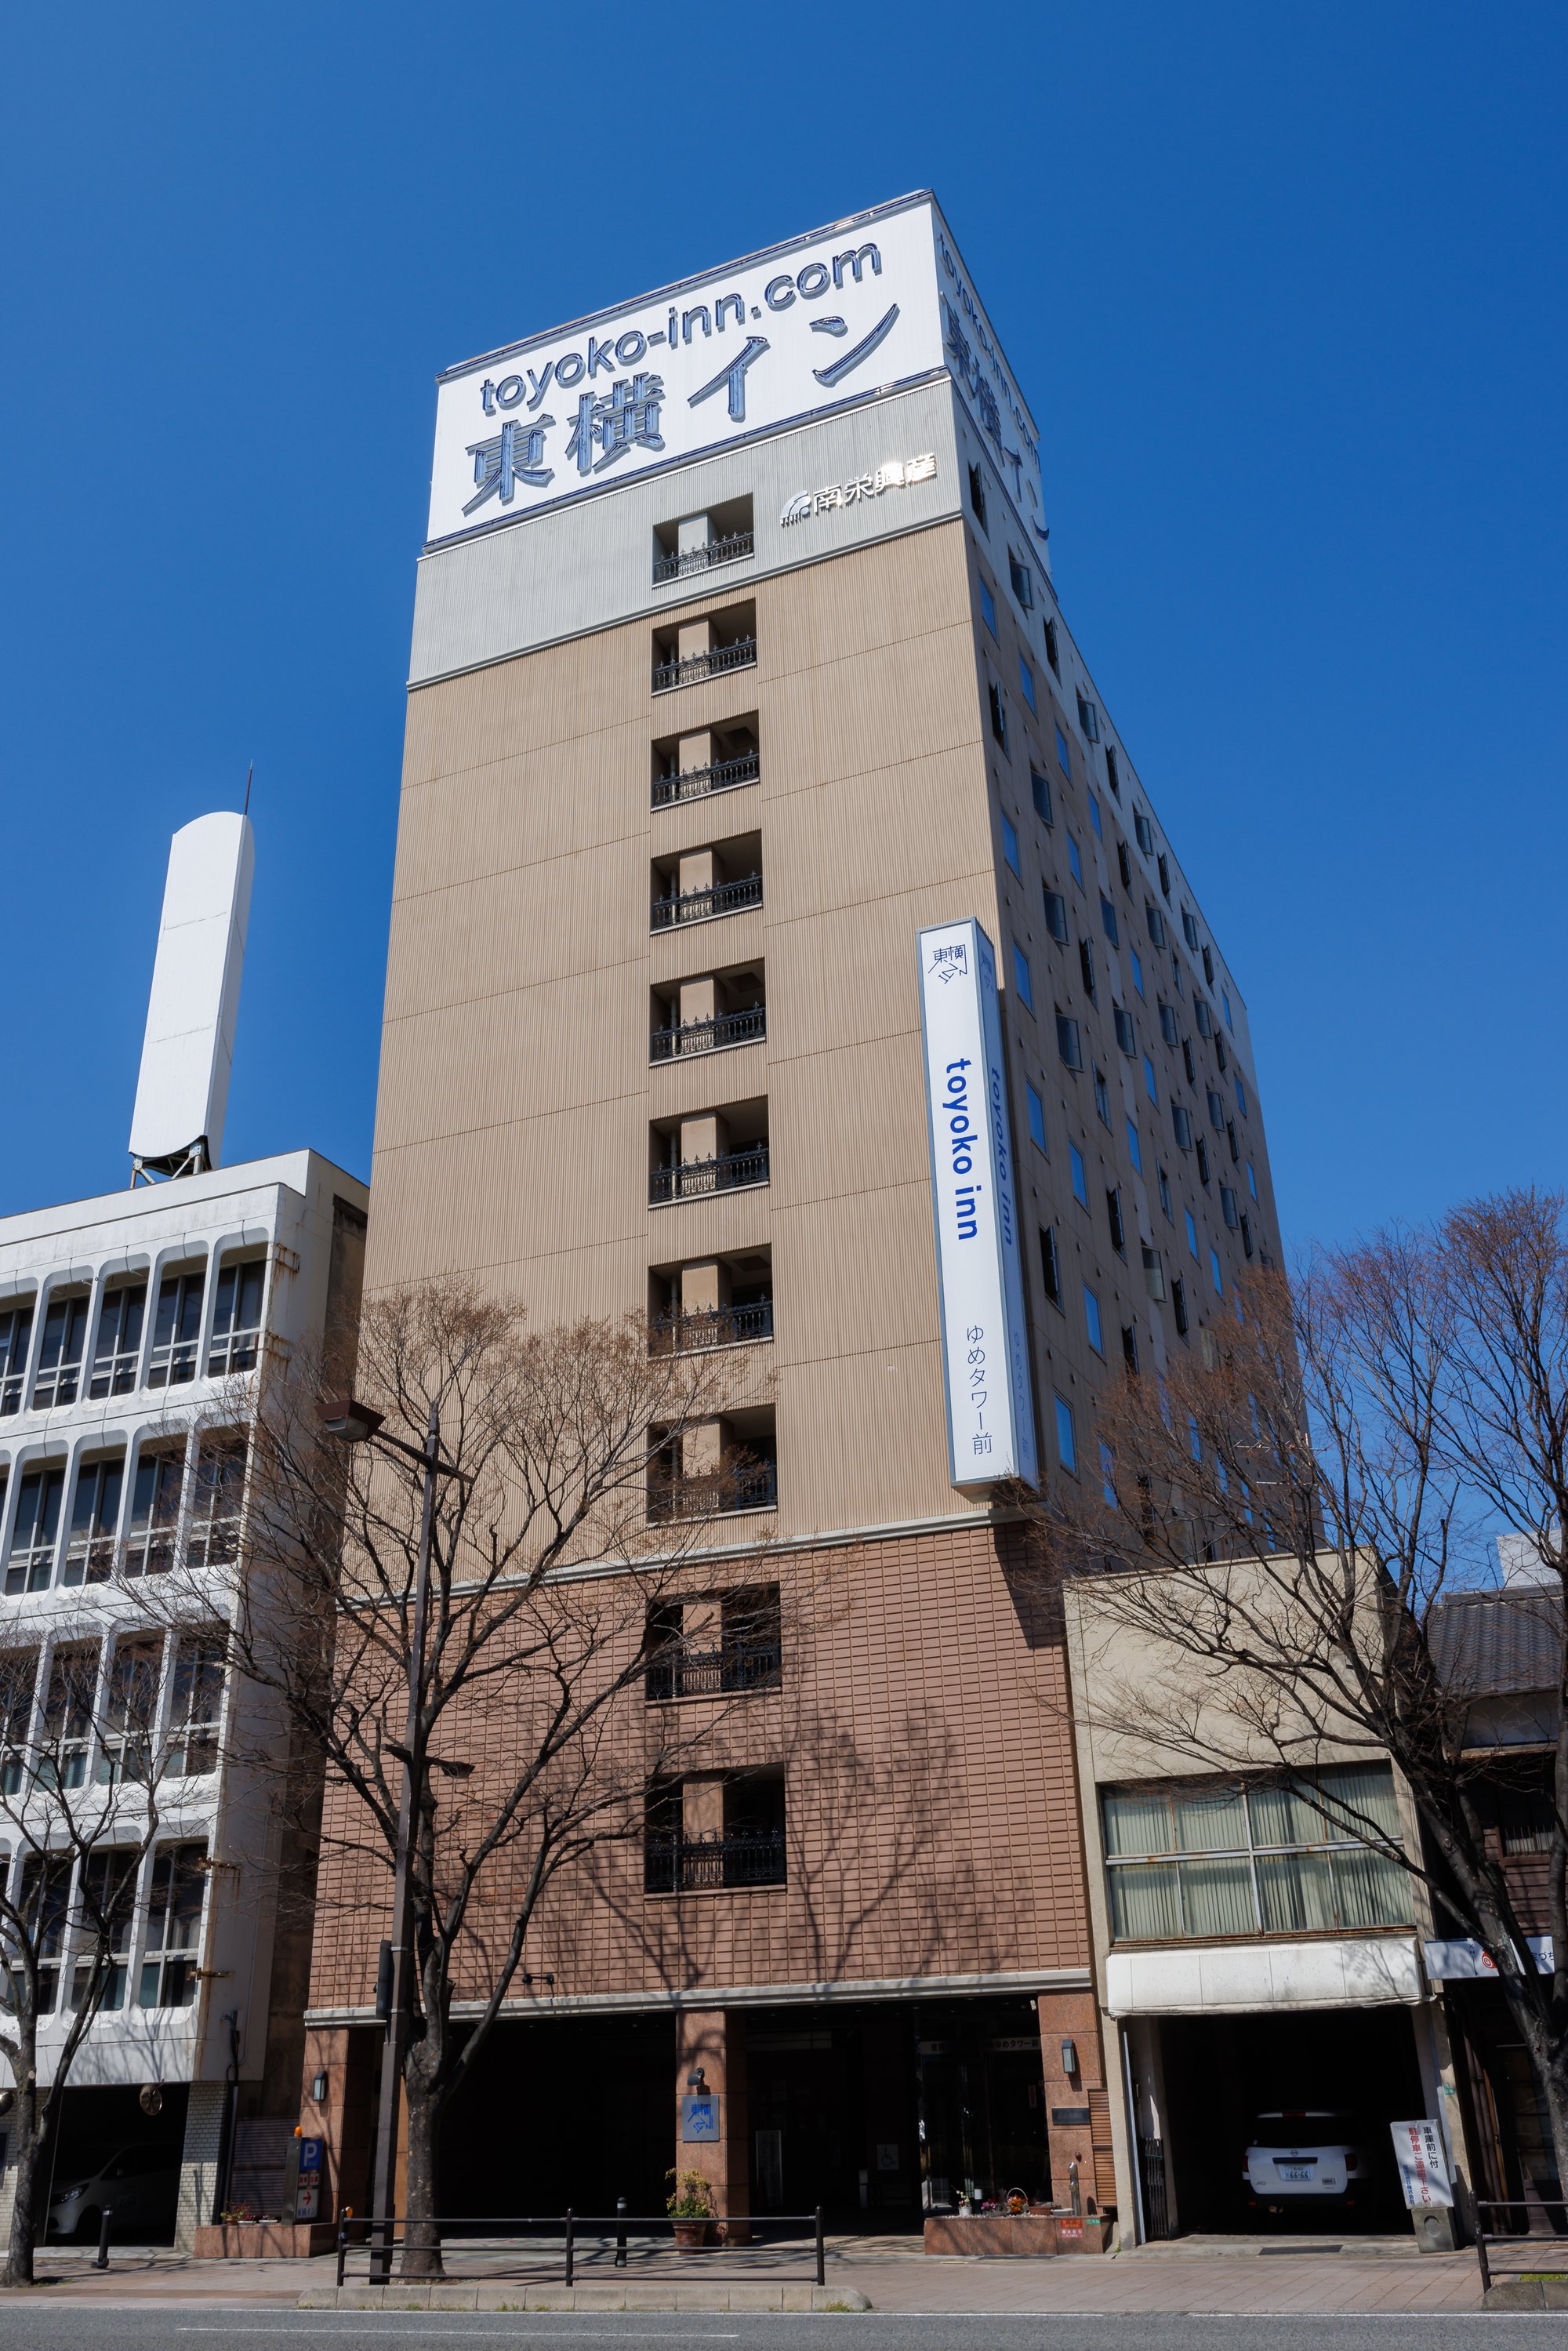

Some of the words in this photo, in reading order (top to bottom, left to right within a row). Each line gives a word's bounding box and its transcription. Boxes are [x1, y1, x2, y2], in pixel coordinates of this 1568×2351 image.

[481, 242, 881, 415] toyoko-inn.com
[462, 304, 900, 516] 東横イン
[942, 1058, 978, 1174] toyoko
[992, 1067, 1007, 1181] toyoko
[1002, 1191, 1012, 1245] inn
[955, 1185, 982, 1240] inn
[966, 1325, 992, 1455] ゆめタワー前
[303, 2143, 318, 2167] P
[1408, 2126, 1431, 2203] 駐停車ご遠慮下さい
[1423, 2126, 1438, 2168] 車庫前に付
